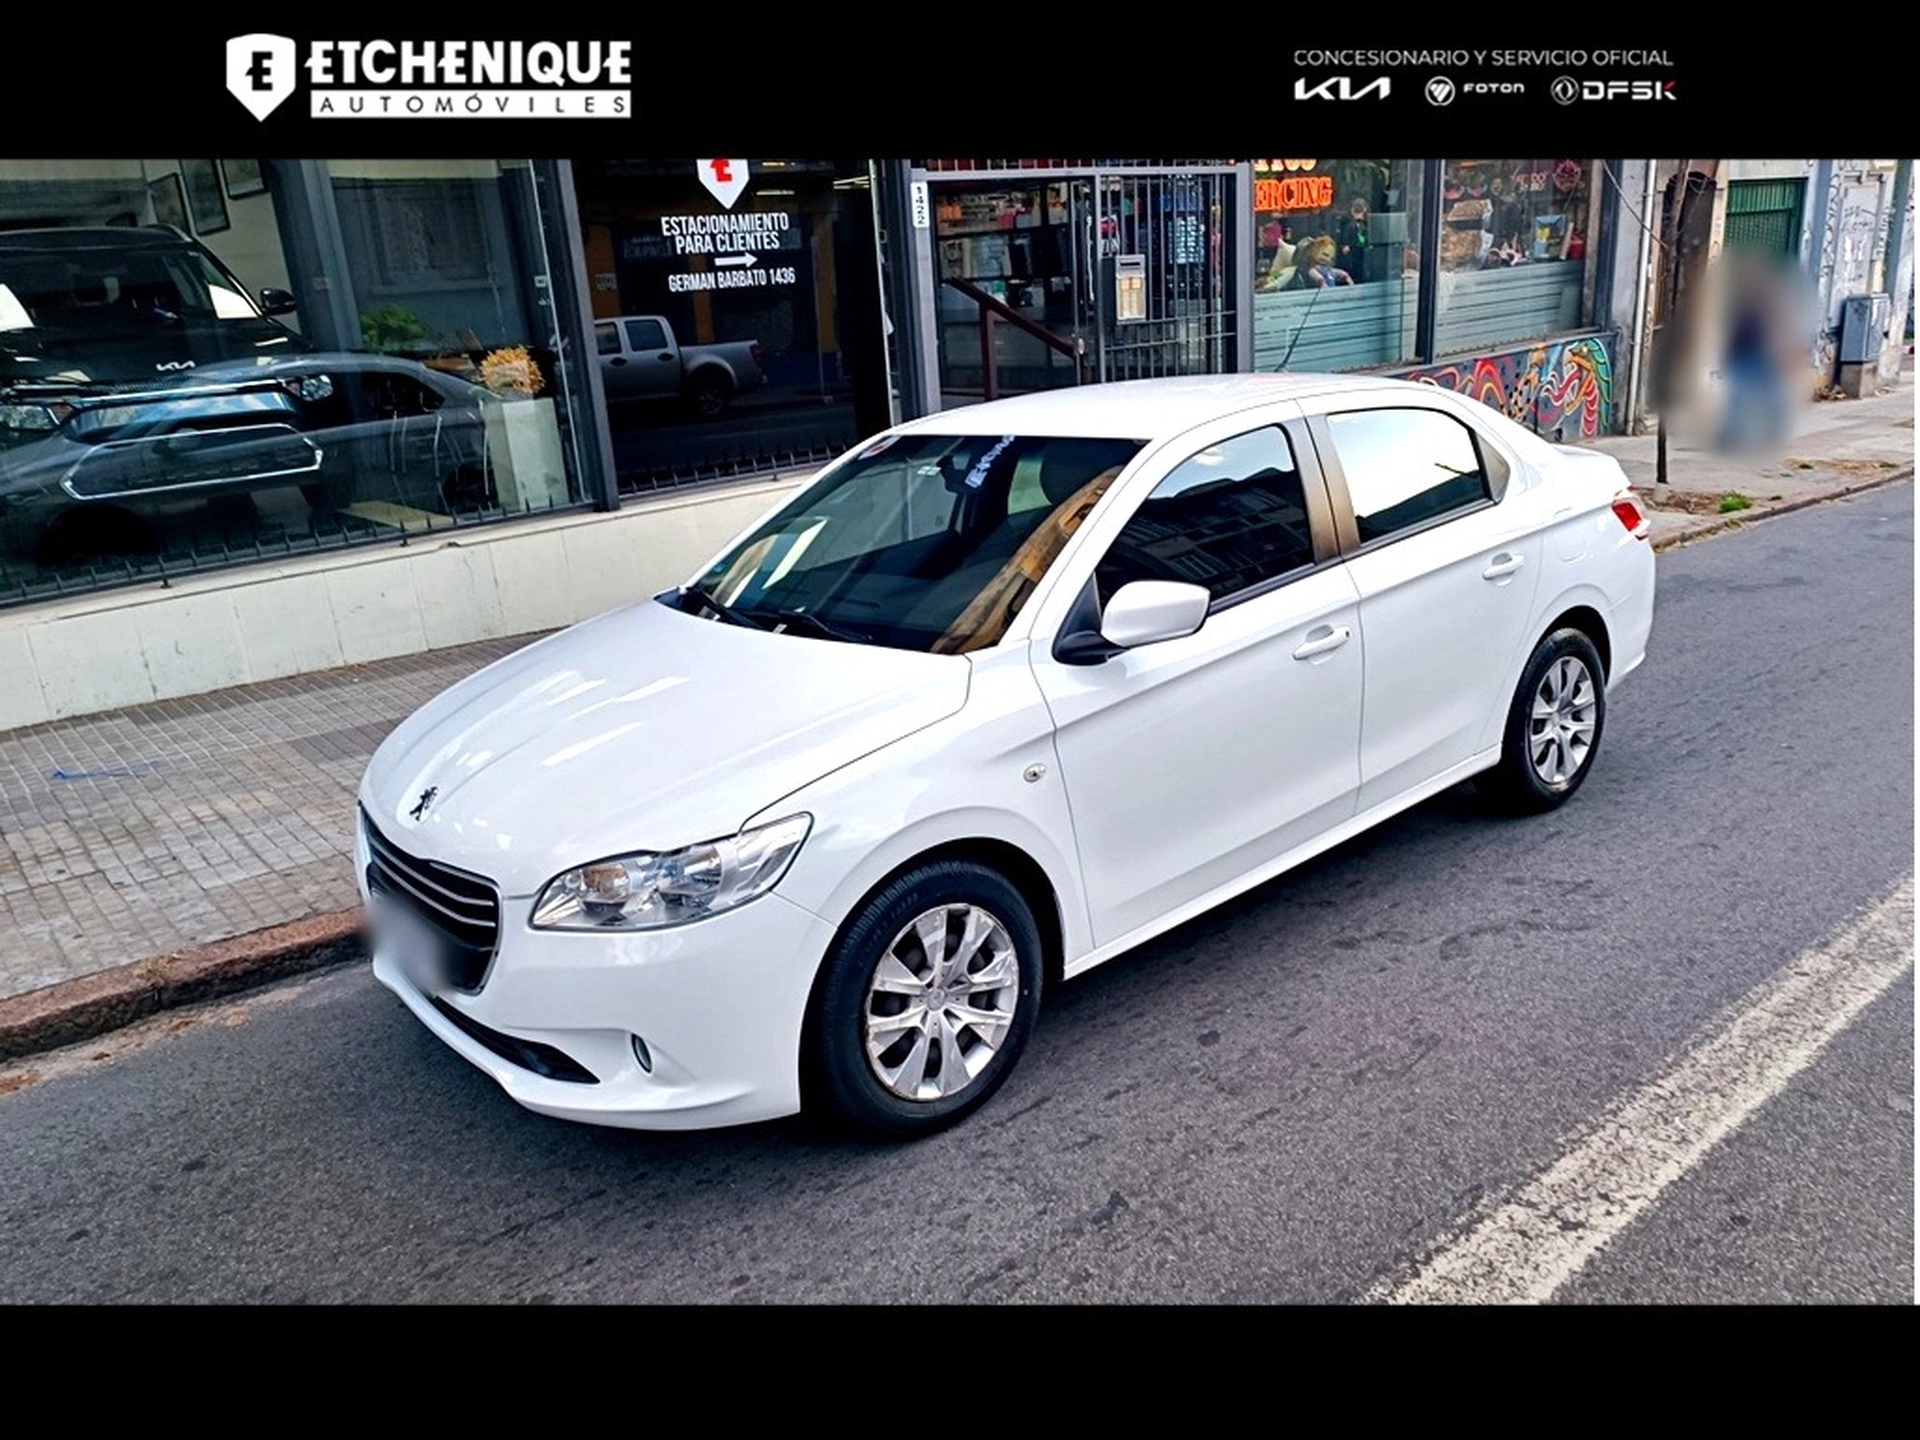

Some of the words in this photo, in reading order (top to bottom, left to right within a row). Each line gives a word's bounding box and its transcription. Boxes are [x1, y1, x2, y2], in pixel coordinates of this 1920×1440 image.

[660, 212, 789, 237] ESTACIONAMIENTO
[675, 234, 714, 255] PARA
[715, 231, 780, 251] CLIENTES
[668, 272, 717, 293] GERMAN
[717, 268, 767, 289] BARBATO
[769, 266, 796, 285] 1436
